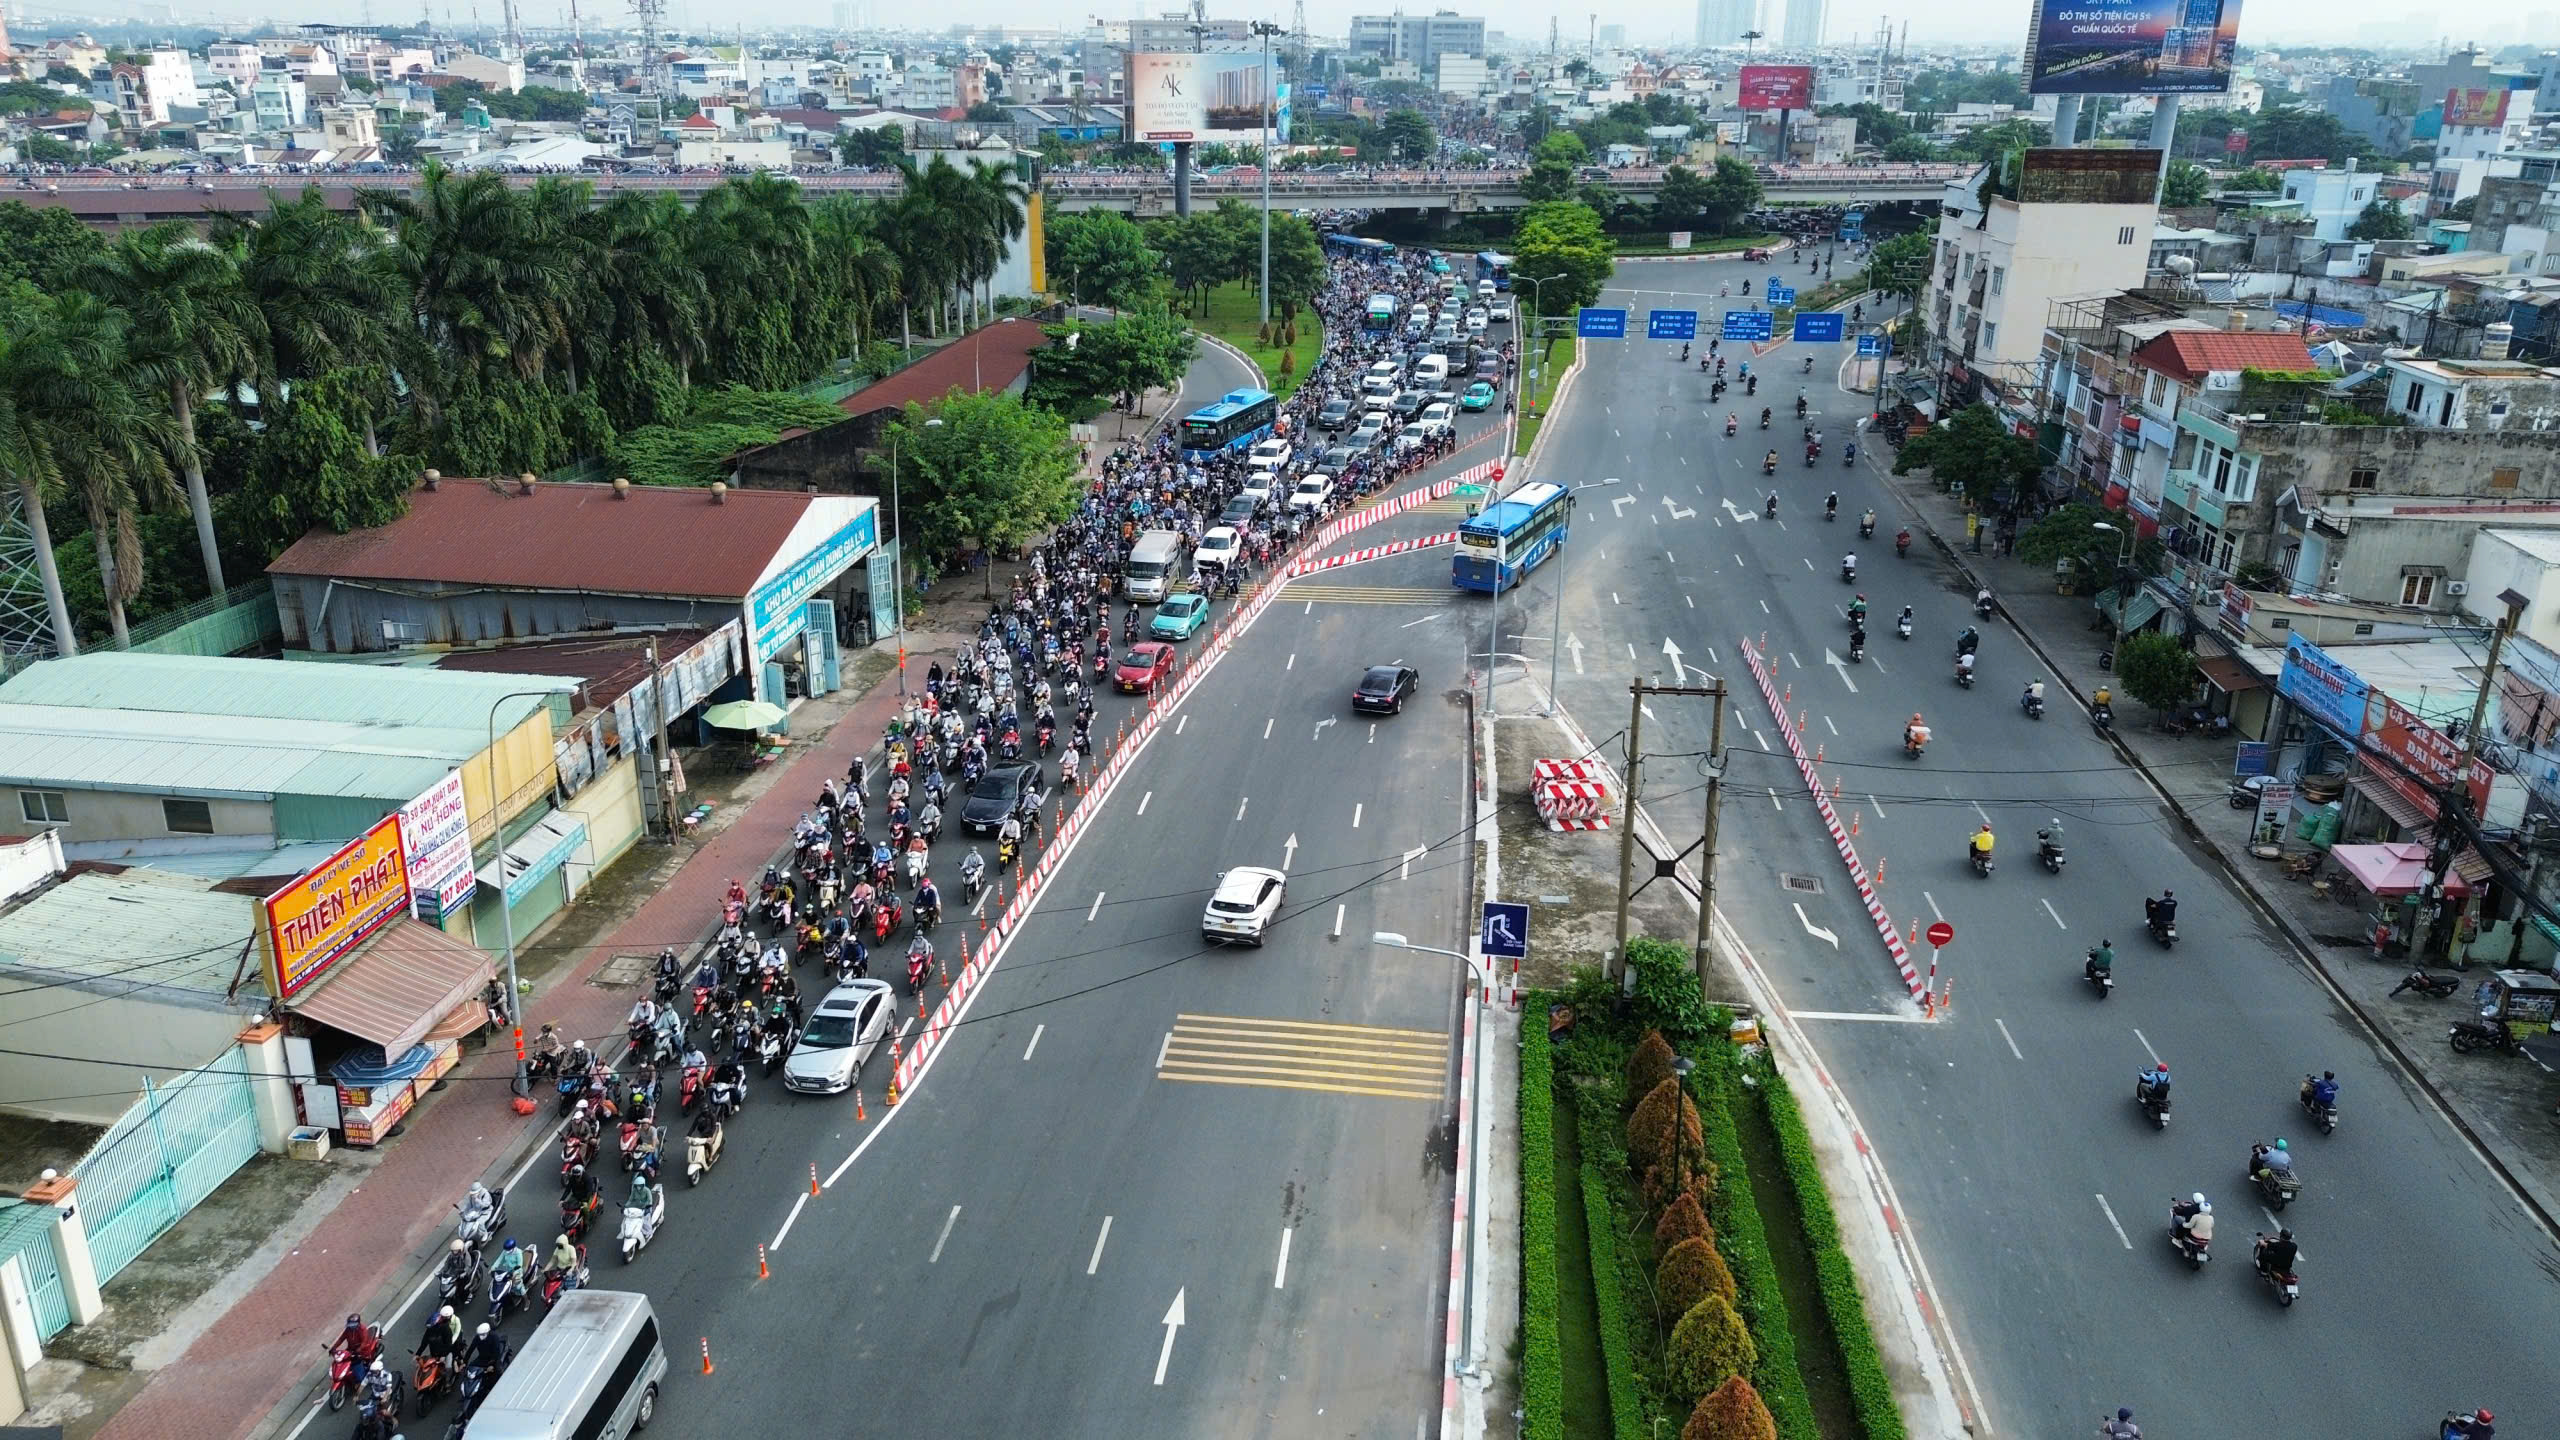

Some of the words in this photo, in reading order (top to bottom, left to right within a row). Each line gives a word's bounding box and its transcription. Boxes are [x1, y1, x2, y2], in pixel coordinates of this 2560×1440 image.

[2059, 9, 2074, 20] ĐÔ
[2074, 12, 2088, 23] THỊ
[2089, 9, 2103, 20] SỐ
[2104, 10, 2122, 23] TIỆN
[2122, 10, 2138, 20] ÍCH
[2100, 22, 2127, 33] QUỐC
[2127, 22, 2138, 34] TẾ
[764, 592, 780, 615] KHO
[780, 580, 792, 603] ĐÁ
[2389, 705, 2404, 724] CÀ
[455, 870, 474, 895] 8008
[283, 888, 345, 954] THIÊN
